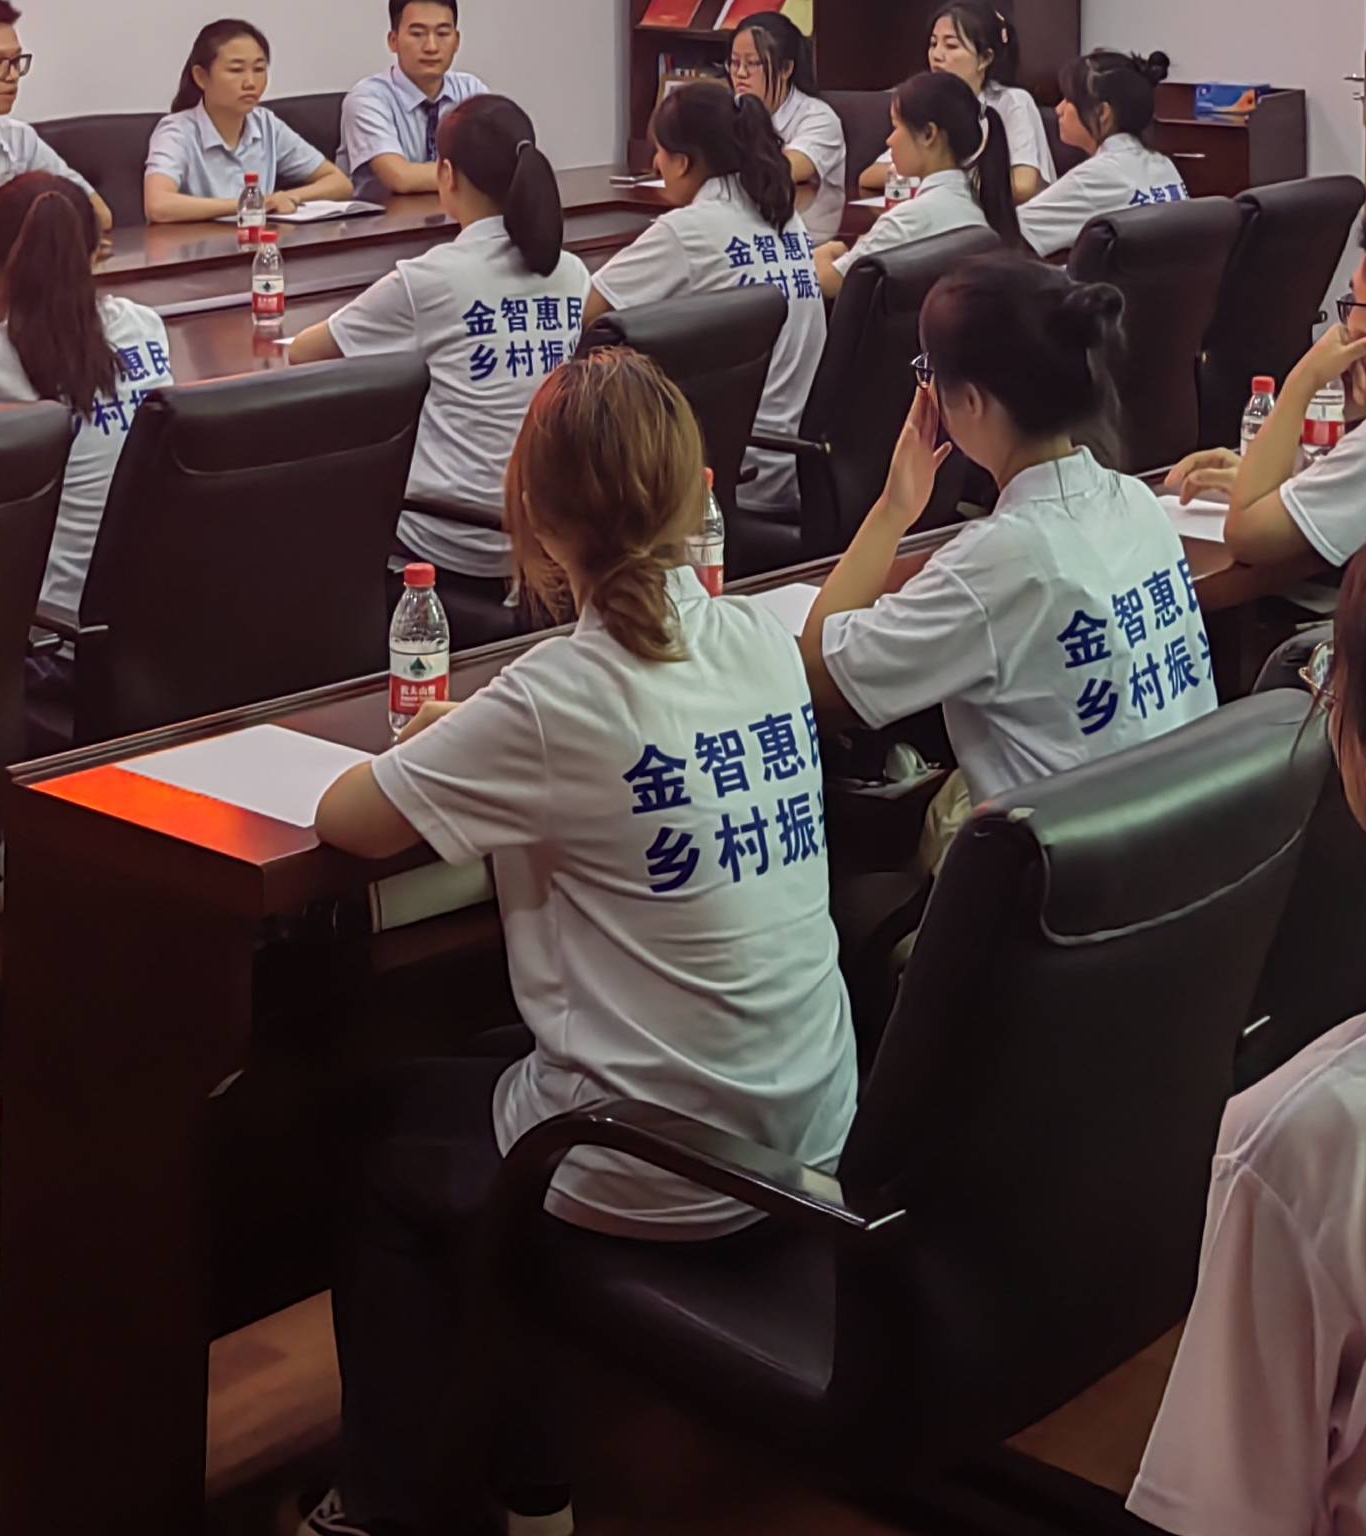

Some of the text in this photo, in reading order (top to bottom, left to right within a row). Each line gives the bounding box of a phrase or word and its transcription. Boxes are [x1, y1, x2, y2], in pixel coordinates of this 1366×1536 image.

[469, 338, 580, 382] 乡村振
[645, 792, 827, 893] 乡村振
